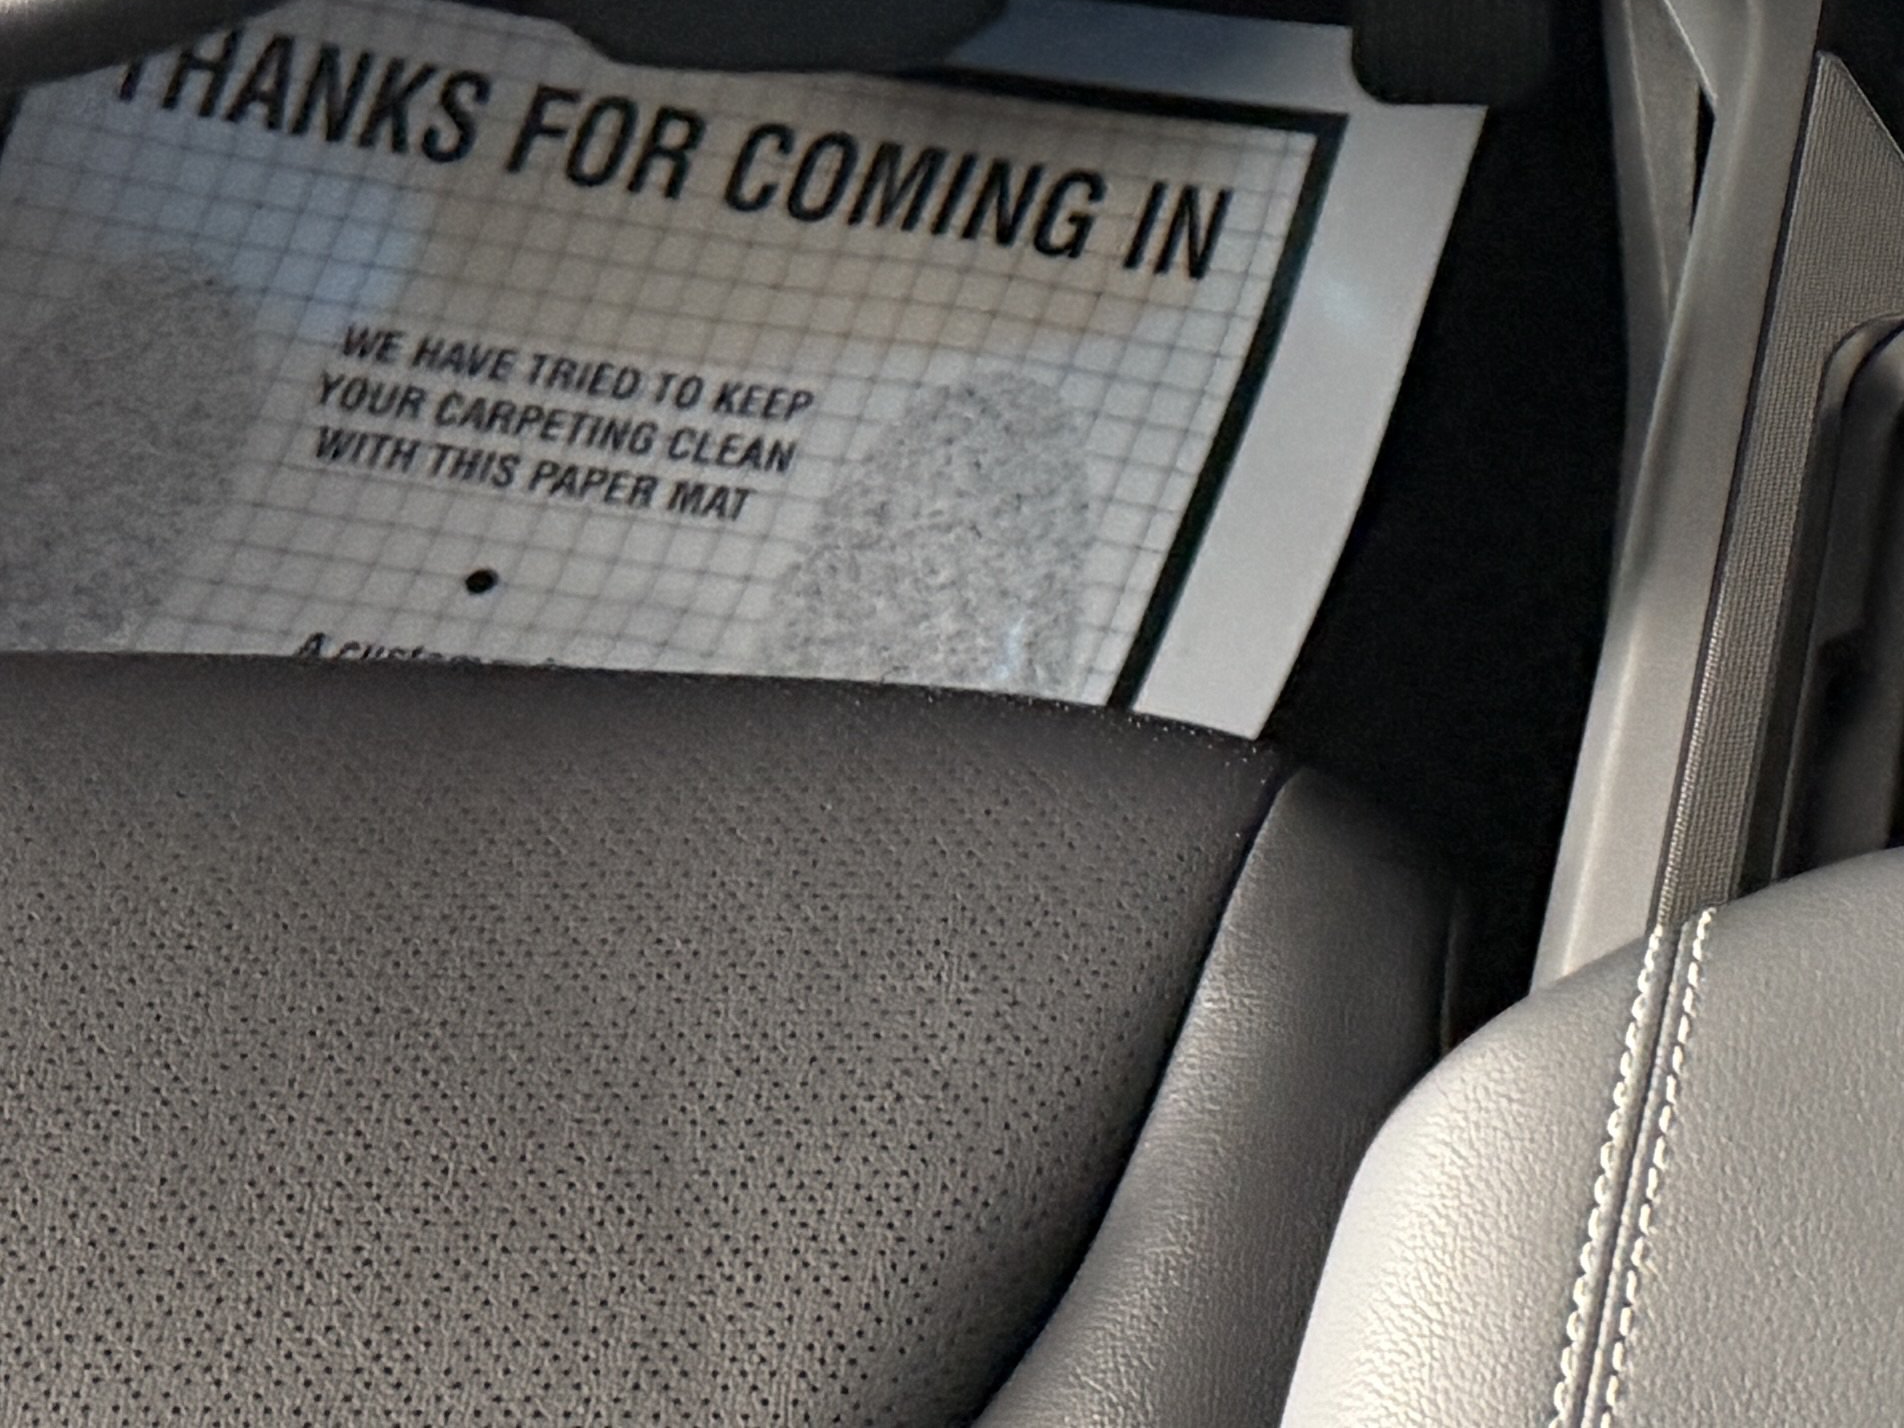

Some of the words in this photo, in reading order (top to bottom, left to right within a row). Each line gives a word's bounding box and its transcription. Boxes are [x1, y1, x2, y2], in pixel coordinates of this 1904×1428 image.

[506, 83, 707, 201] FOR
[723, 122, 1108, 260] COMING
[1123, 178, 1235, 281] IN
[318, 370, 427, 420] YOUR
[435, 390, 658, 456] CARPETING
[667, 425, 799, 474] CLEAN
[342, 323, 404, 364] WE
[412, 335, 519, 382] HAVE
[529, 352, 641, 403] TRIED
[654, 370, 706, 411] TO
[714, 379, 815, 423] KEEP
[316, 425, 417, 473] WITH
[427, 440, 522, 489] THIS
[528, 459, 658, 511] PAPER
[667, 479, 756, 523] MAT
